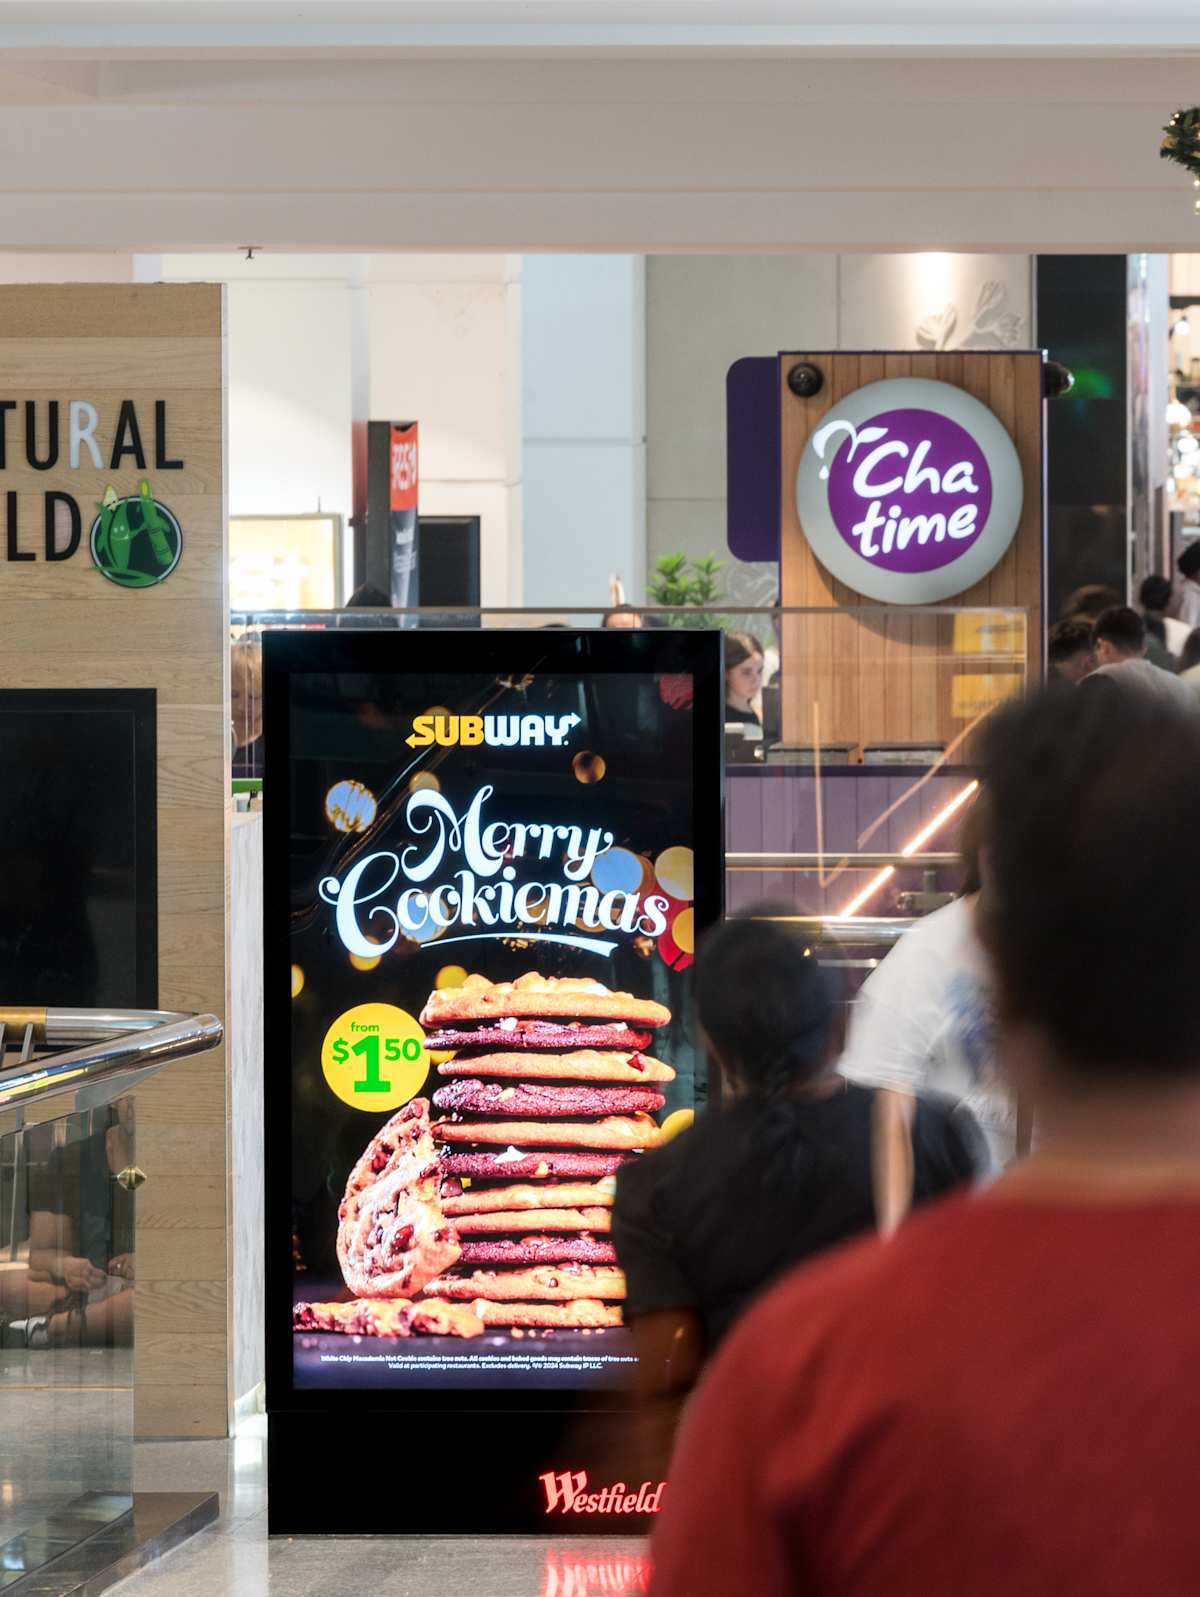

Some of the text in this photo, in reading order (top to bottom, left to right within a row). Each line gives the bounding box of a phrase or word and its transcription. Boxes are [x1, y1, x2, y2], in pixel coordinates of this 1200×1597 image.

[0, 399, 184, 471] TURAL
[852, 439, 979, 498] Cha
[7, 491, 82, 562] LD
[852, 501, 978, 557] time
[405, 712, 582, 749] SUBWAY
[401, 785, 613, 882] Merry
[318, 851, 670, 958] Cookiemas
[351, 1022, 380, 1032] from
[538, 1470, 667, 1514] Westfield
